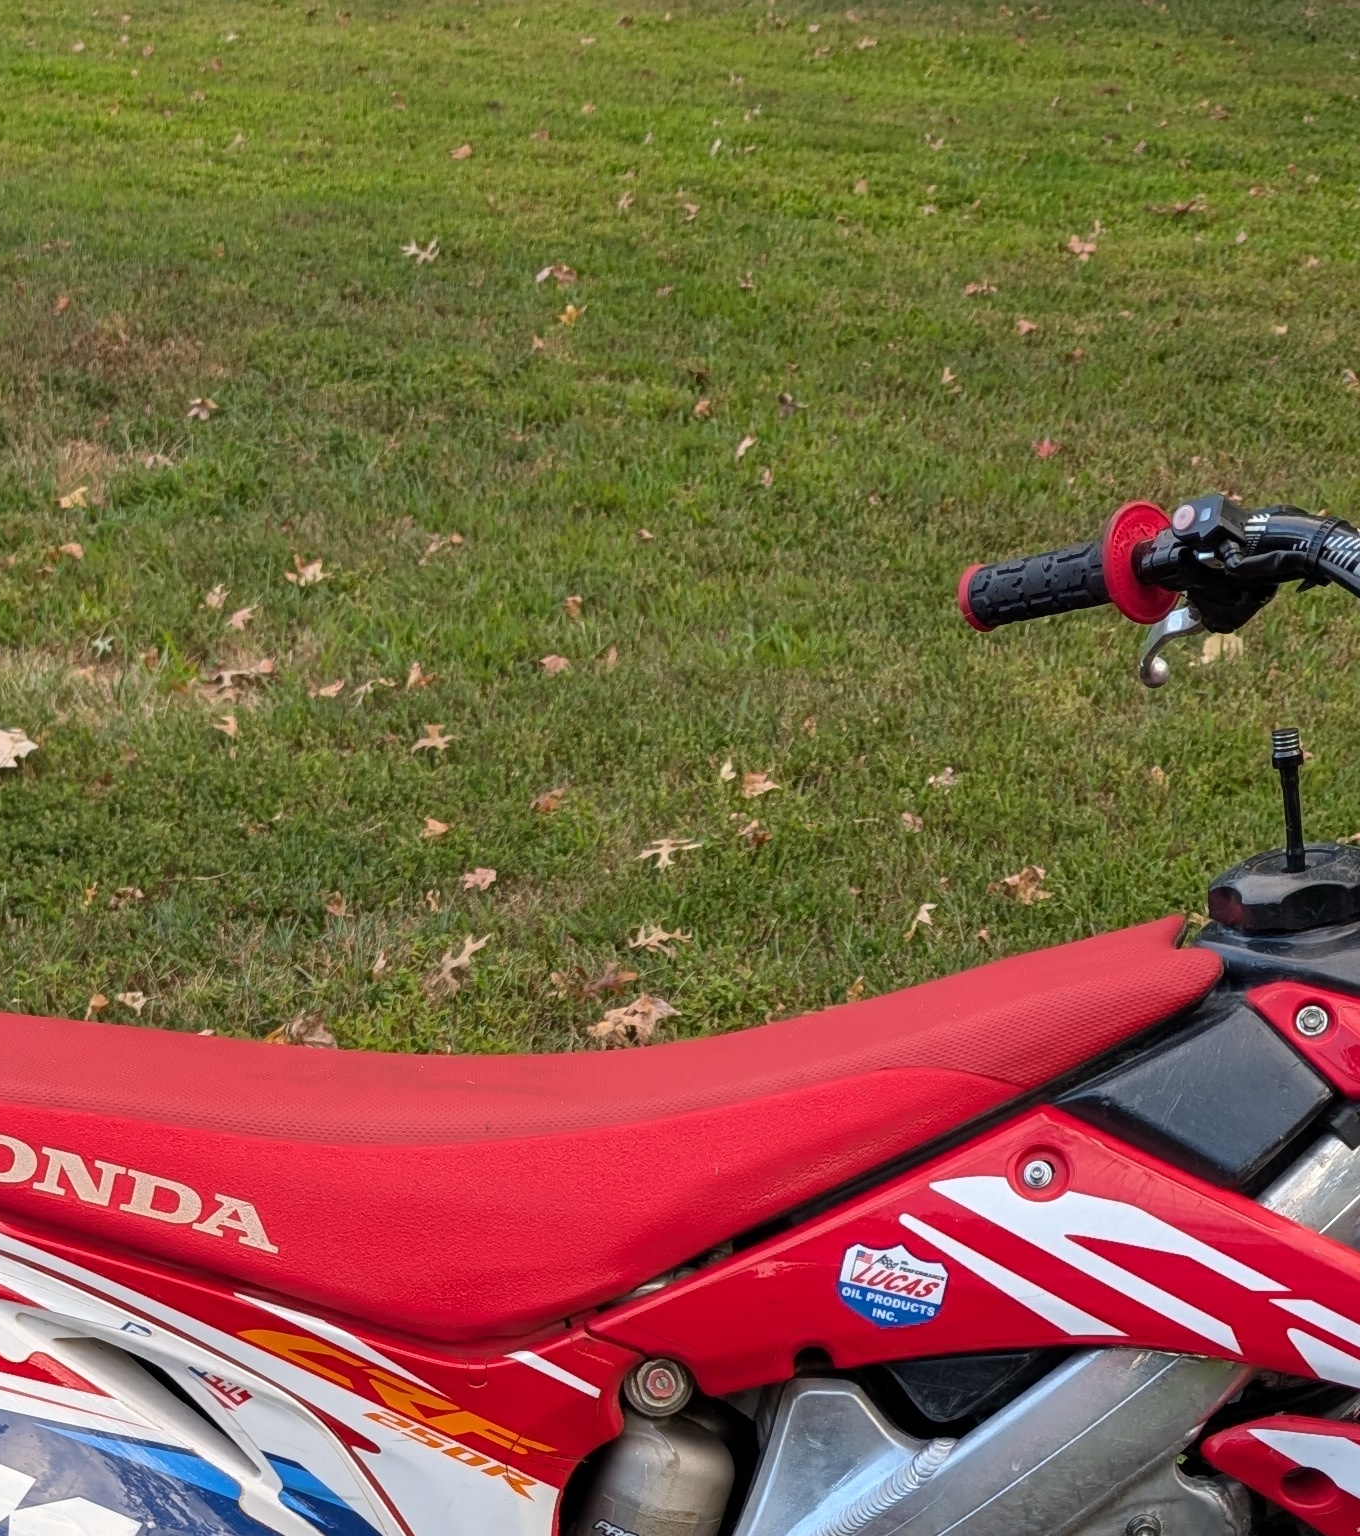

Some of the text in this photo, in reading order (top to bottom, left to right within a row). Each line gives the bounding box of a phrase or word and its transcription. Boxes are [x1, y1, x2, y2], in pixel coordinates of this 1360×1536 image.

[852, 1266, 940, 1298] LUCAS
[841, 1287, 936, 1317] OIL PRODUCTS
[872, 1308, 899, 1322] INC.
[237, 1329, 560, 1455] CRF
[363, 1411, 538, 1502] 250R
